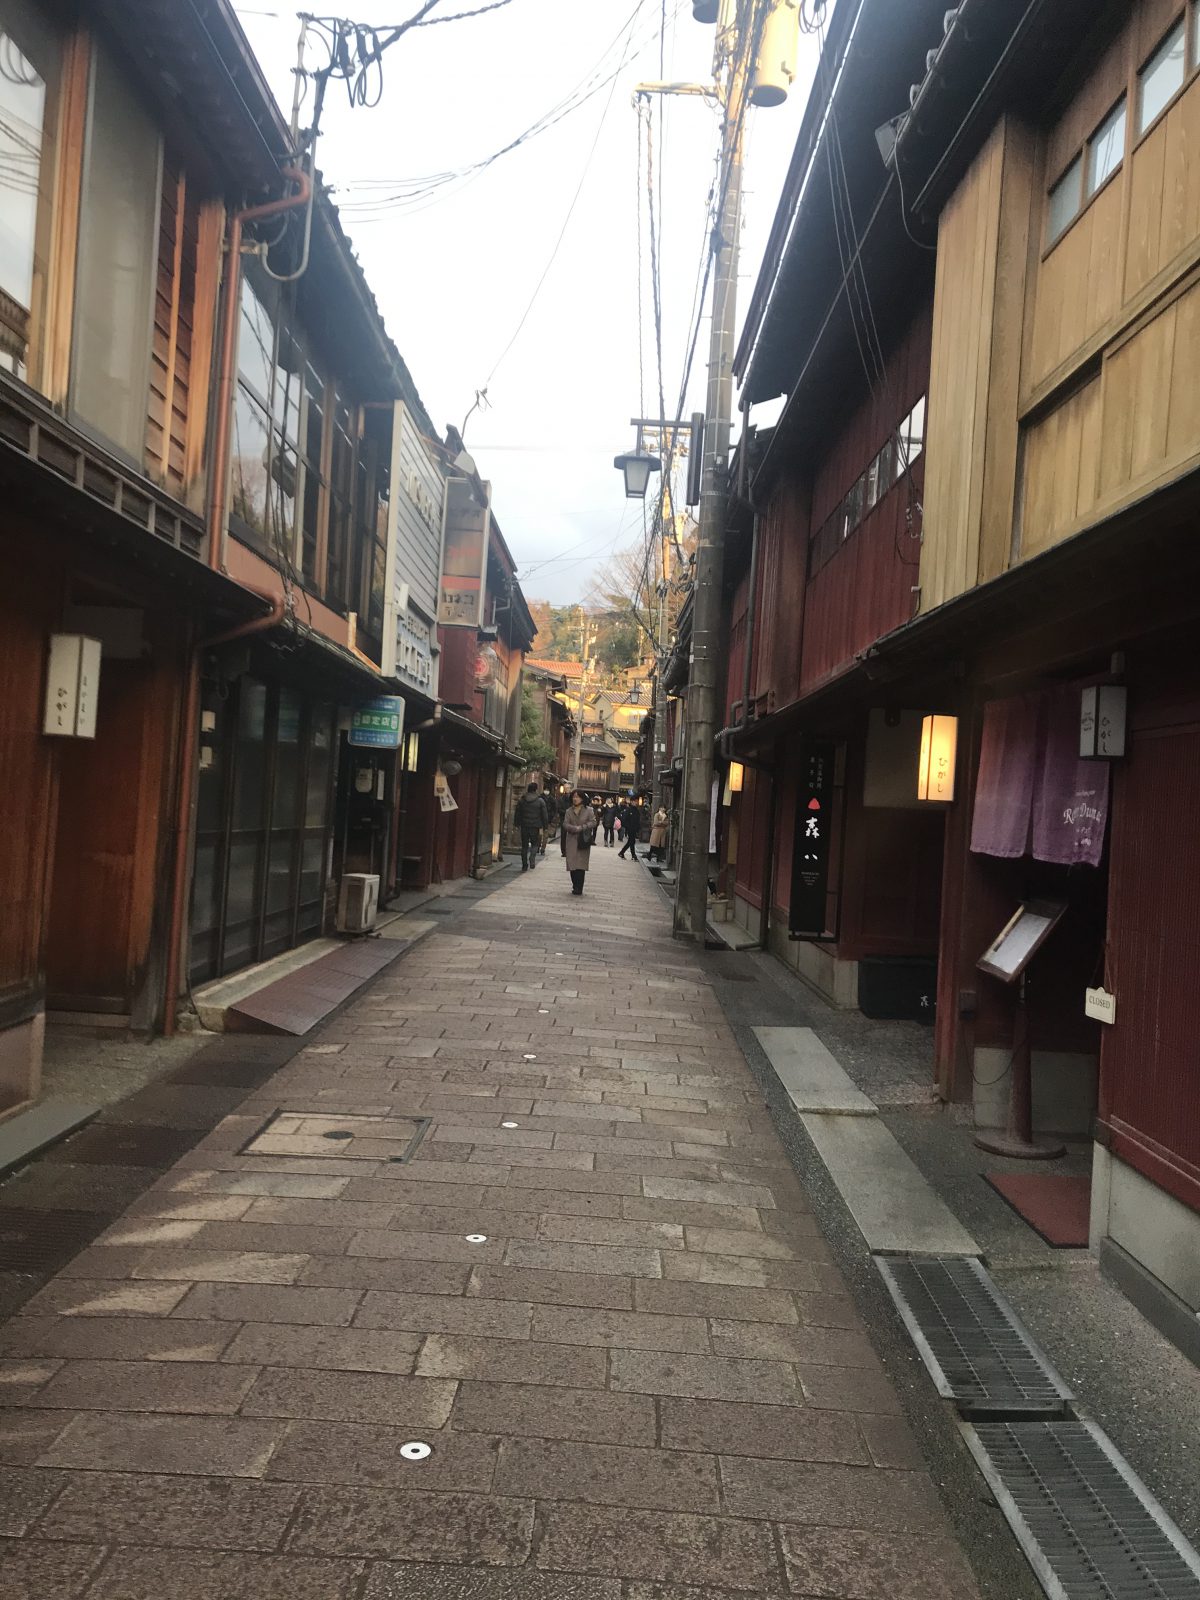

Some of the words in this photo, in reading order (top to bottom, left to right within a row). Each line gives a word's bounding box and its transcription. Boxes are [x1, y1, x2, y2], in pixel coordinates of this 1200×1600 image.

[1101, 716, 1111, 754] ひがし
[938, 757, 948, 793] ひがし
[1088, 996, 1111, 1009] CLOSED
